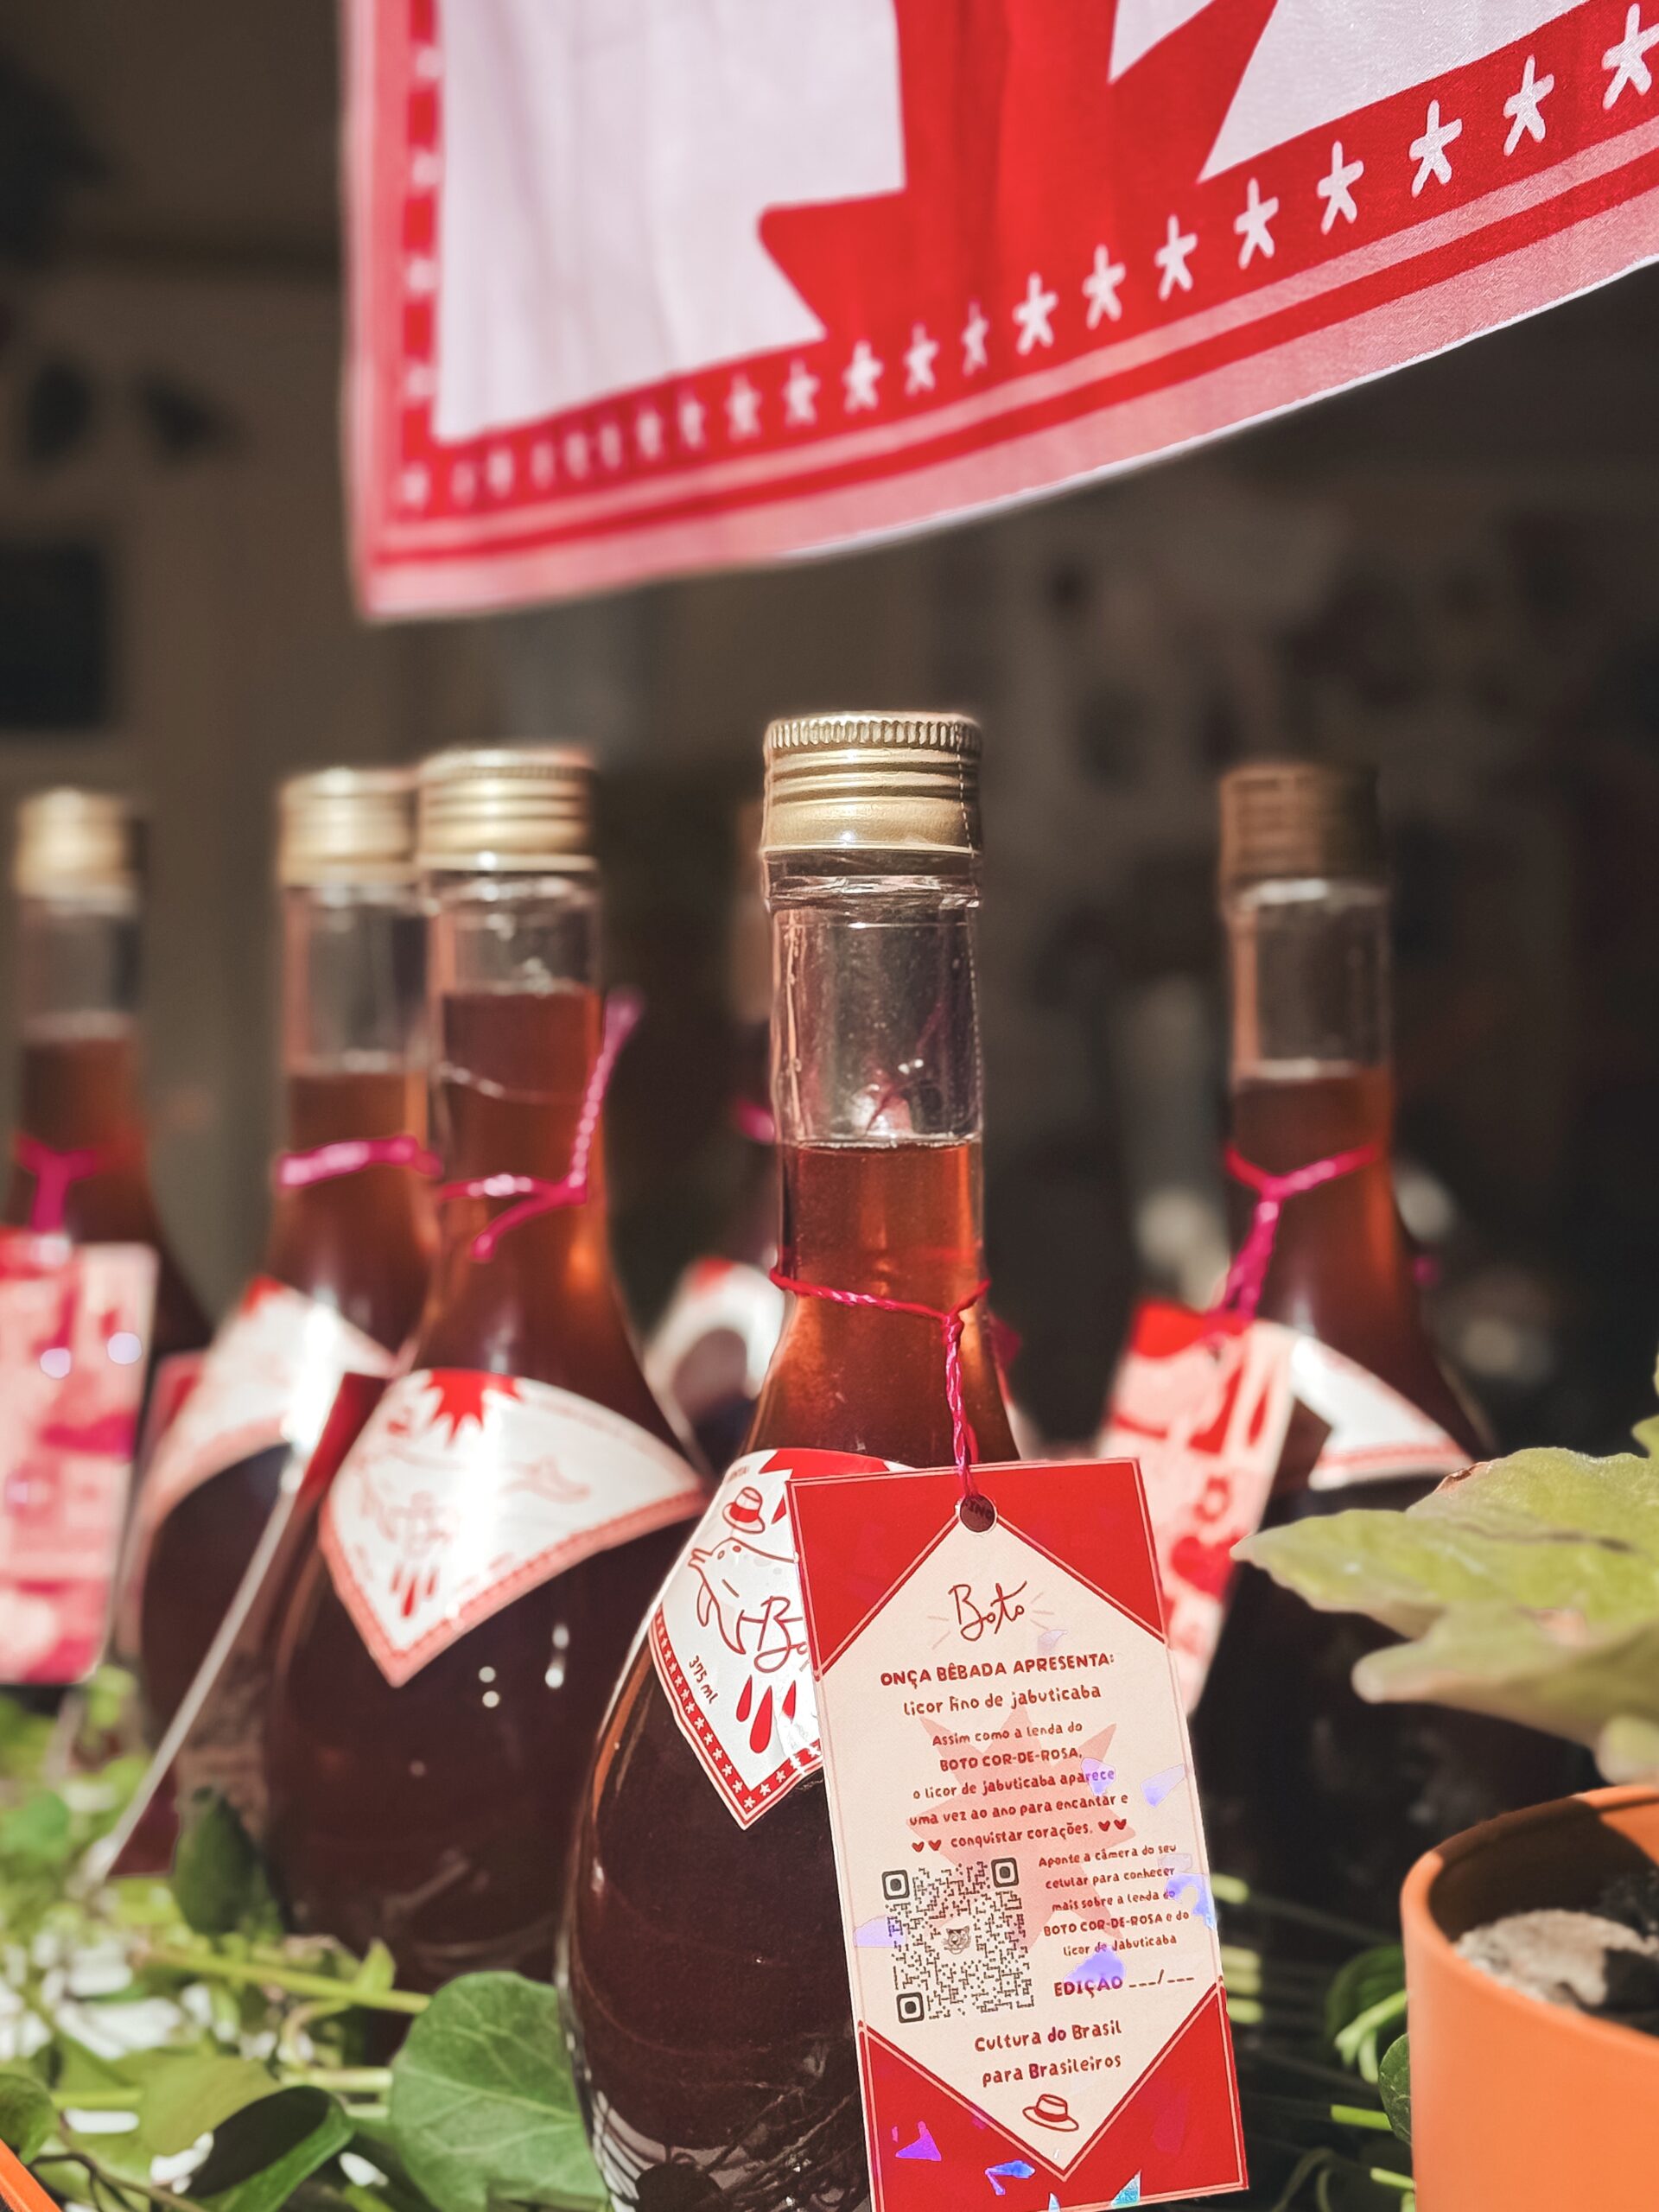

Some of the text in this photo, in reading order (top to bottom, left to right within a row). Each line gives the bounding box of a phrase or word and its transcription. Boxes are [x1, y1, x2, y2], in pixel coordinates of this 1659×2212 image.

[948, 1581, 1028, 1641] Boto
[753, 1596, 809, 1674] Bo
[689, 1655, 718, 1705] 375 ml
[880, 1653, 1115, 1689] ONÇA BÊBADA APRESENTA:
[904, 1684, 1101, 1716] licor fino de jabuticaba
[932, 1721, 1083, 1746] Assim como a lenda do
[940, 1747, 1083, 1772] BOTO COR-DE-ROSA,
[912, 1770, 1115, 1799] o licor de jabuticaba aparece
[909, 1793, 1128, 1827] uma vez ao ano para encantar e
[950, 1829, 1022, 1848] conquistar
[1039, 1844, 1177, 1867] Aponte a câmera do seu
[1046, 1866, 1175, 1890] celular para conhecer
[1052, 1888, 1175, 1912] mais sobre a lenda do
[1044, 1910, 1189, 1937] BOTO COR-DE-ROSA e do
[1063, 1945, 1090, 1957] licor
[1095, 1942, 1107, 1953] de
[975, 2019, 1122, 2051] Cultura do Brasil
[982, 2055, 1121, 2088] para Brasileiros
